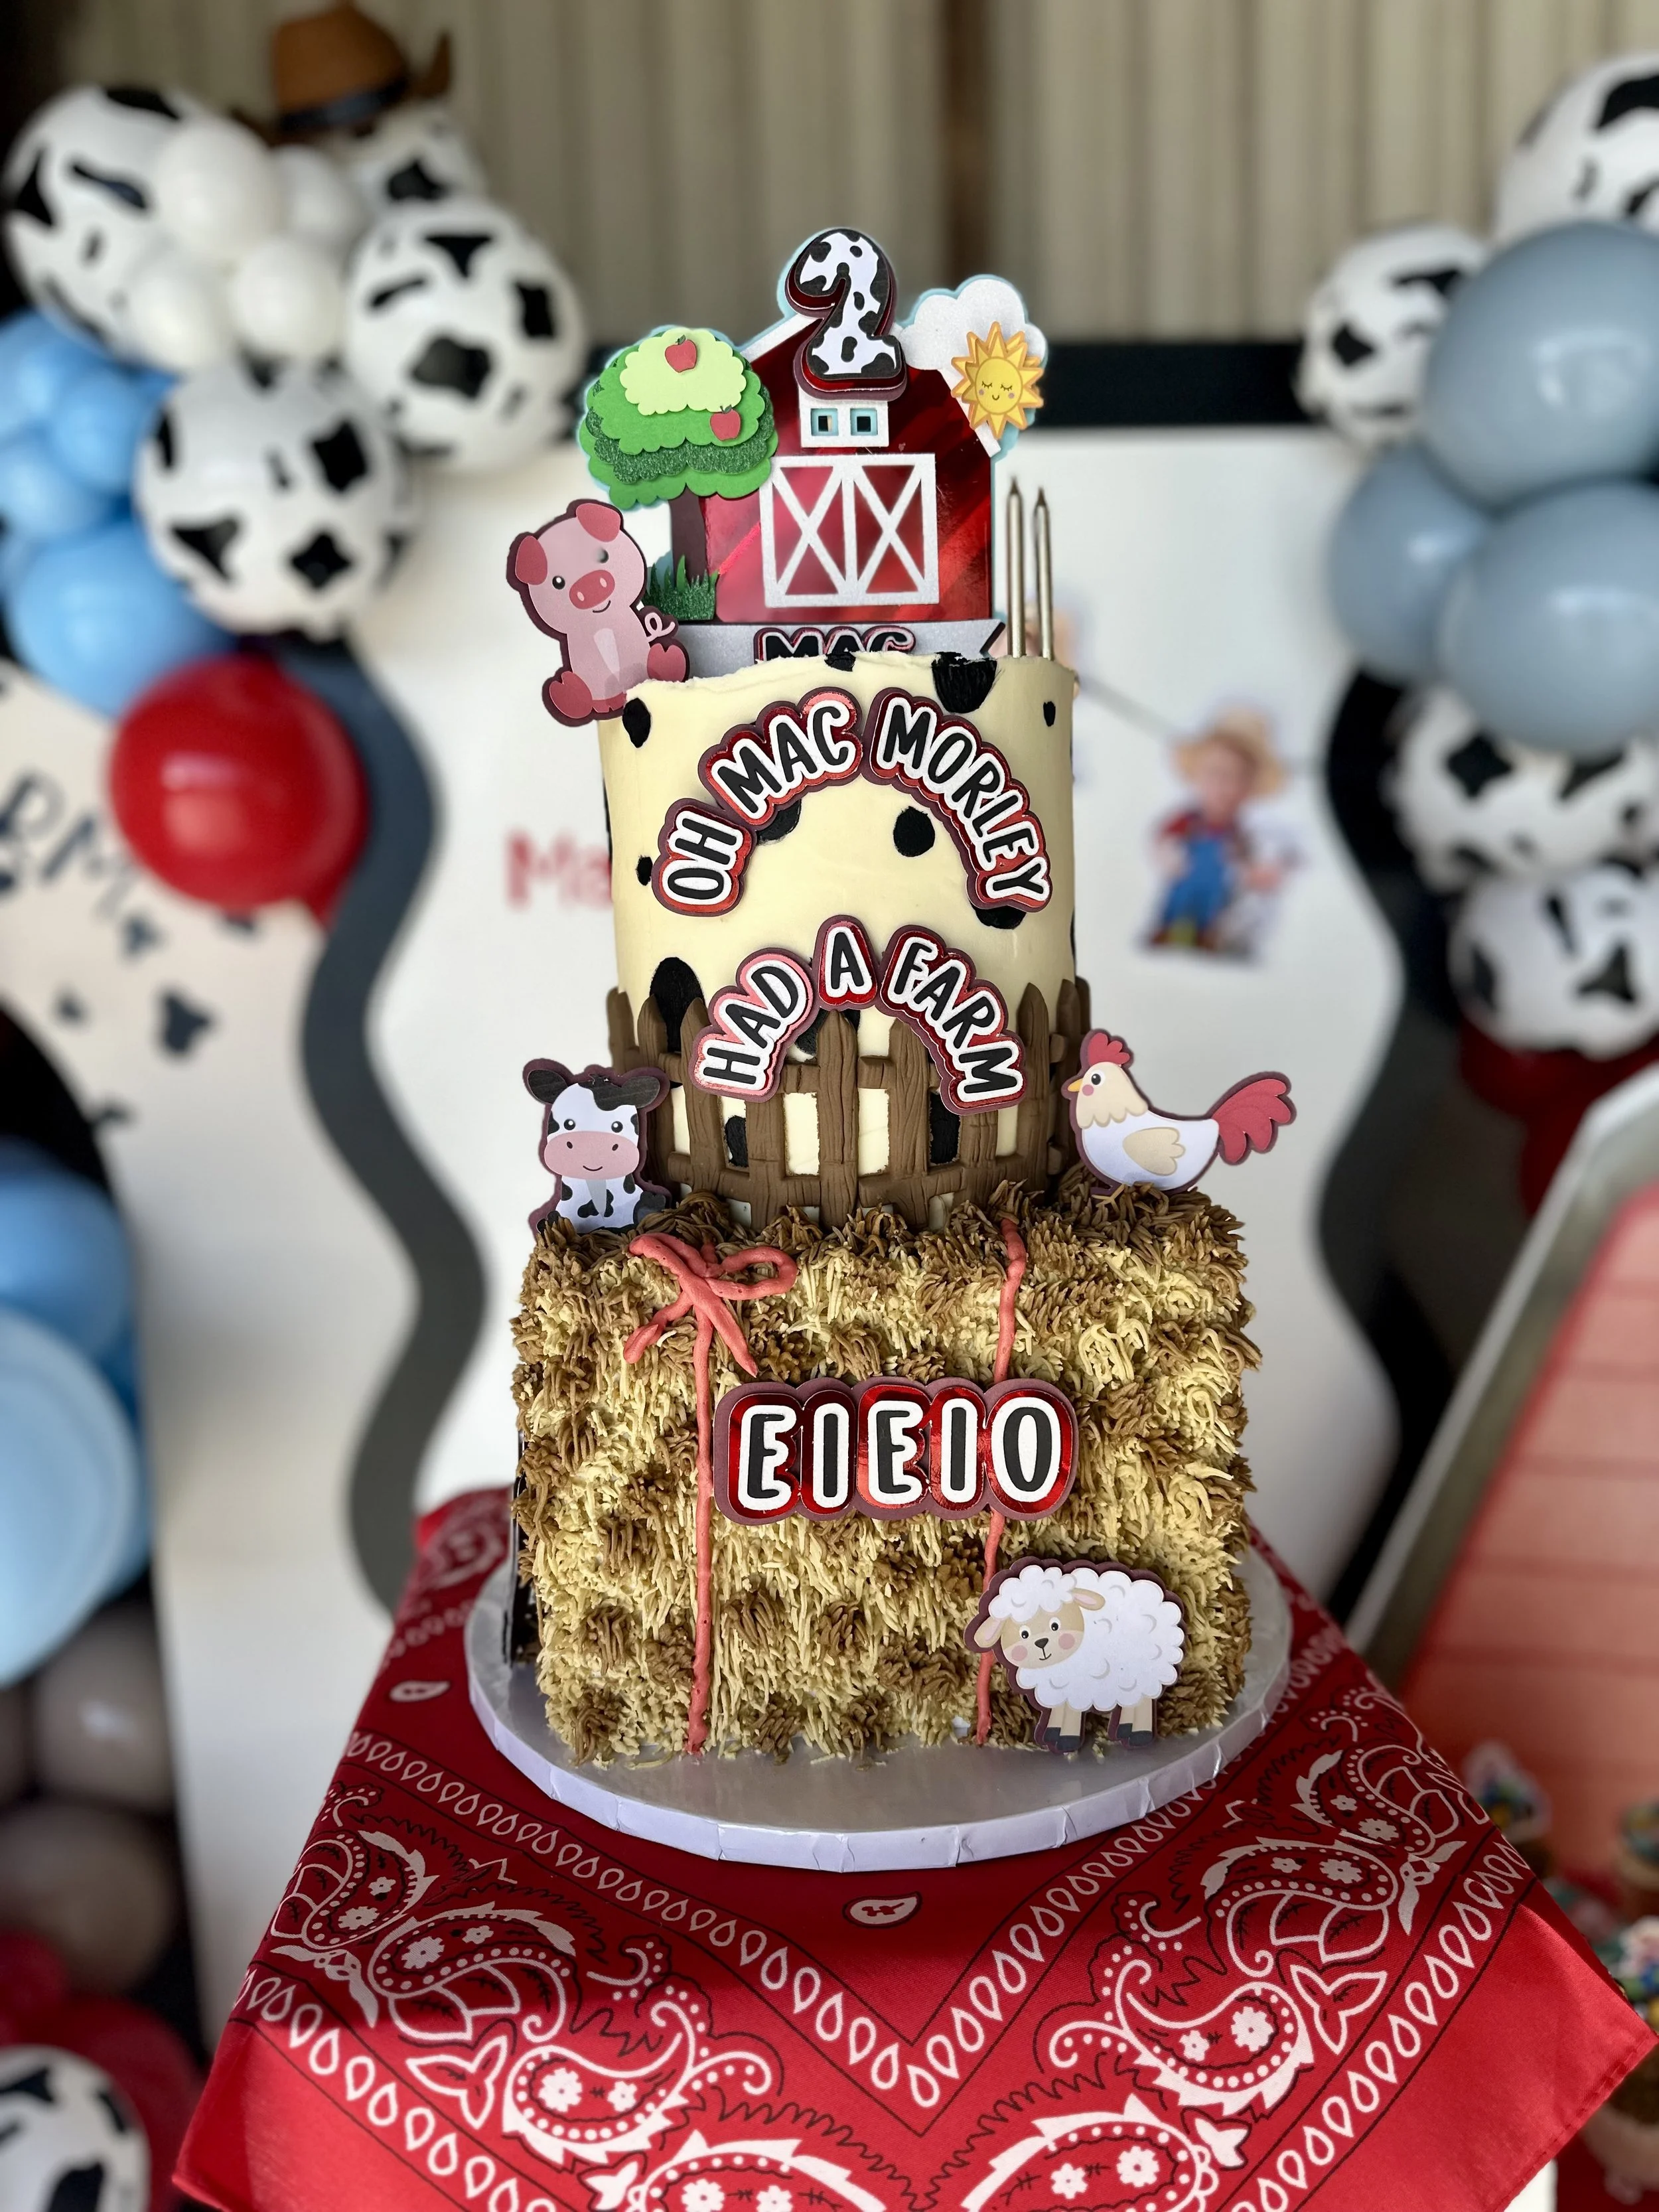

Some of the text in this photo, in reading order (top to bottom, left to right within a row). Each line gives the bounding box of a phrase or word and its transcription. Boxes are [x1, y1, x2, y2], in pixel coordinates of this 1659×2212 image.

[792, 228, 904, 386] 2
[662, 696, 1050, 906] OH MAC MORLEY
[697, 926, 1025, 1102] HAD A FARM
[737, 1396, 1061, 1511] EIEIO
